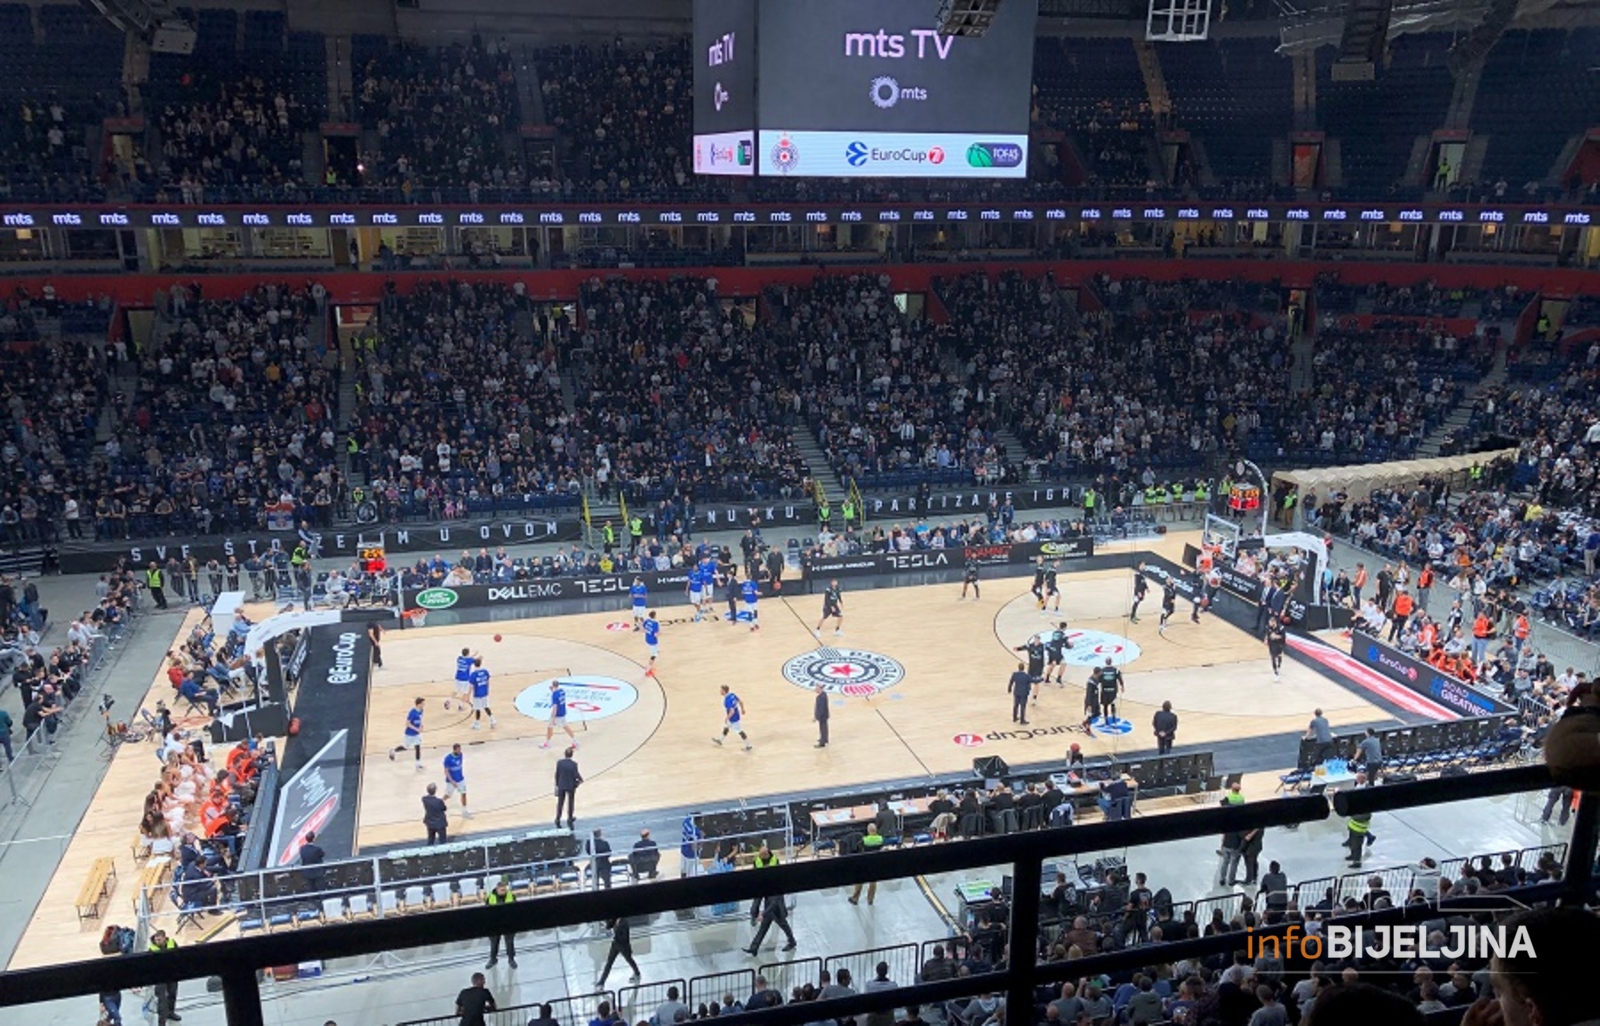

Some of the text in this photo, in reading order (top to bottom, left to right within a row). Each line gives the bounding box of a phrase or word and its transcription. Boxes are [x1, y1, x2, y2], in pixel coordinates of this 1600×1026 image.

[845, 28, 954, 59] mts TV
[901, 86, 927, 100] mts
[871, 148, 927, 164] EuroCup
[4, 208, 1590, 224] mts mts mts mts mts mts mts mts mts mts mts mts mts mts mts mts mts mts mts mts mts mts mts mts mts mts mts mts mts mts mts mts mts mts mts mts mts mts mts mts mts
[440, 527, 450, 541] U
[480, 521, 557, 539] OVOM
[886, 552, 948, 568] TESLA
